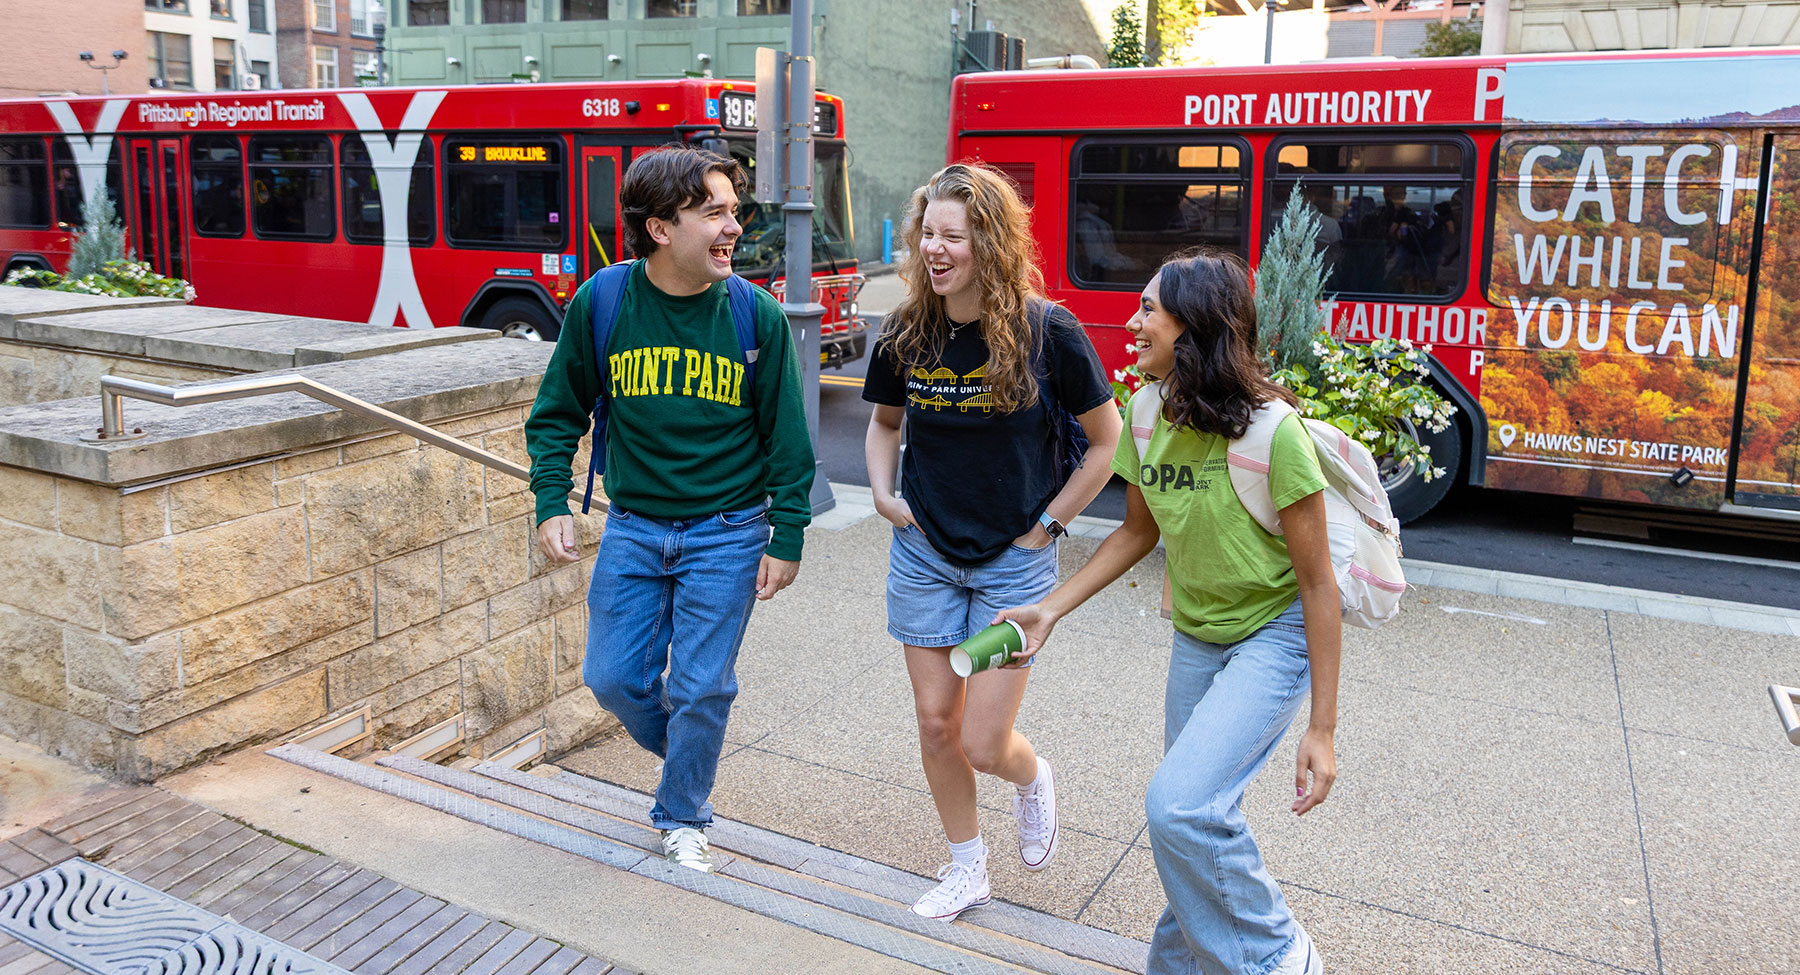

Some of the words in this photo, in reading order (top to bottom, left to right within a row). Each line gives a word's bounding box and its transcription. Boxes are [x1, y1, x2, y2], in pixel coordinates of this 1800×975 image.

[138, 102, 208, 128] Pittsburgh
[208, 100, 272, 127] Regional
[273, 99, 325, 121] Transit
[582, 98, 621, 117] 6318
[1184, 94, 1257, 126] PORT
[1264, 89, 1432, 124] AUTHORITY
[459, 146, 476, 161] 39
[484, 146, 548, 161] BROOKLINE
[1517, 143, 1776, 226] CATCH
[1513, 233, 1690, 291] WHILE
[1348, 303, 1487, 345] AUTHOR
[1508, 295, 1612, 352] YOU
[1624, 300, 1740, 359] CAN
[608, 346, 681, 399] POINT
[682, 348, 746, 407] PARK
[1469, 350, 1484, 376] P
[1523, 431, 1583, 453] HAWKS
[1584, 436, 1628, 457] NEST
[1629, 440, 1679, 462] STATE
[1680, 445, 1728, 467] PARK
[1141, 464, 1195, 492] OPA
